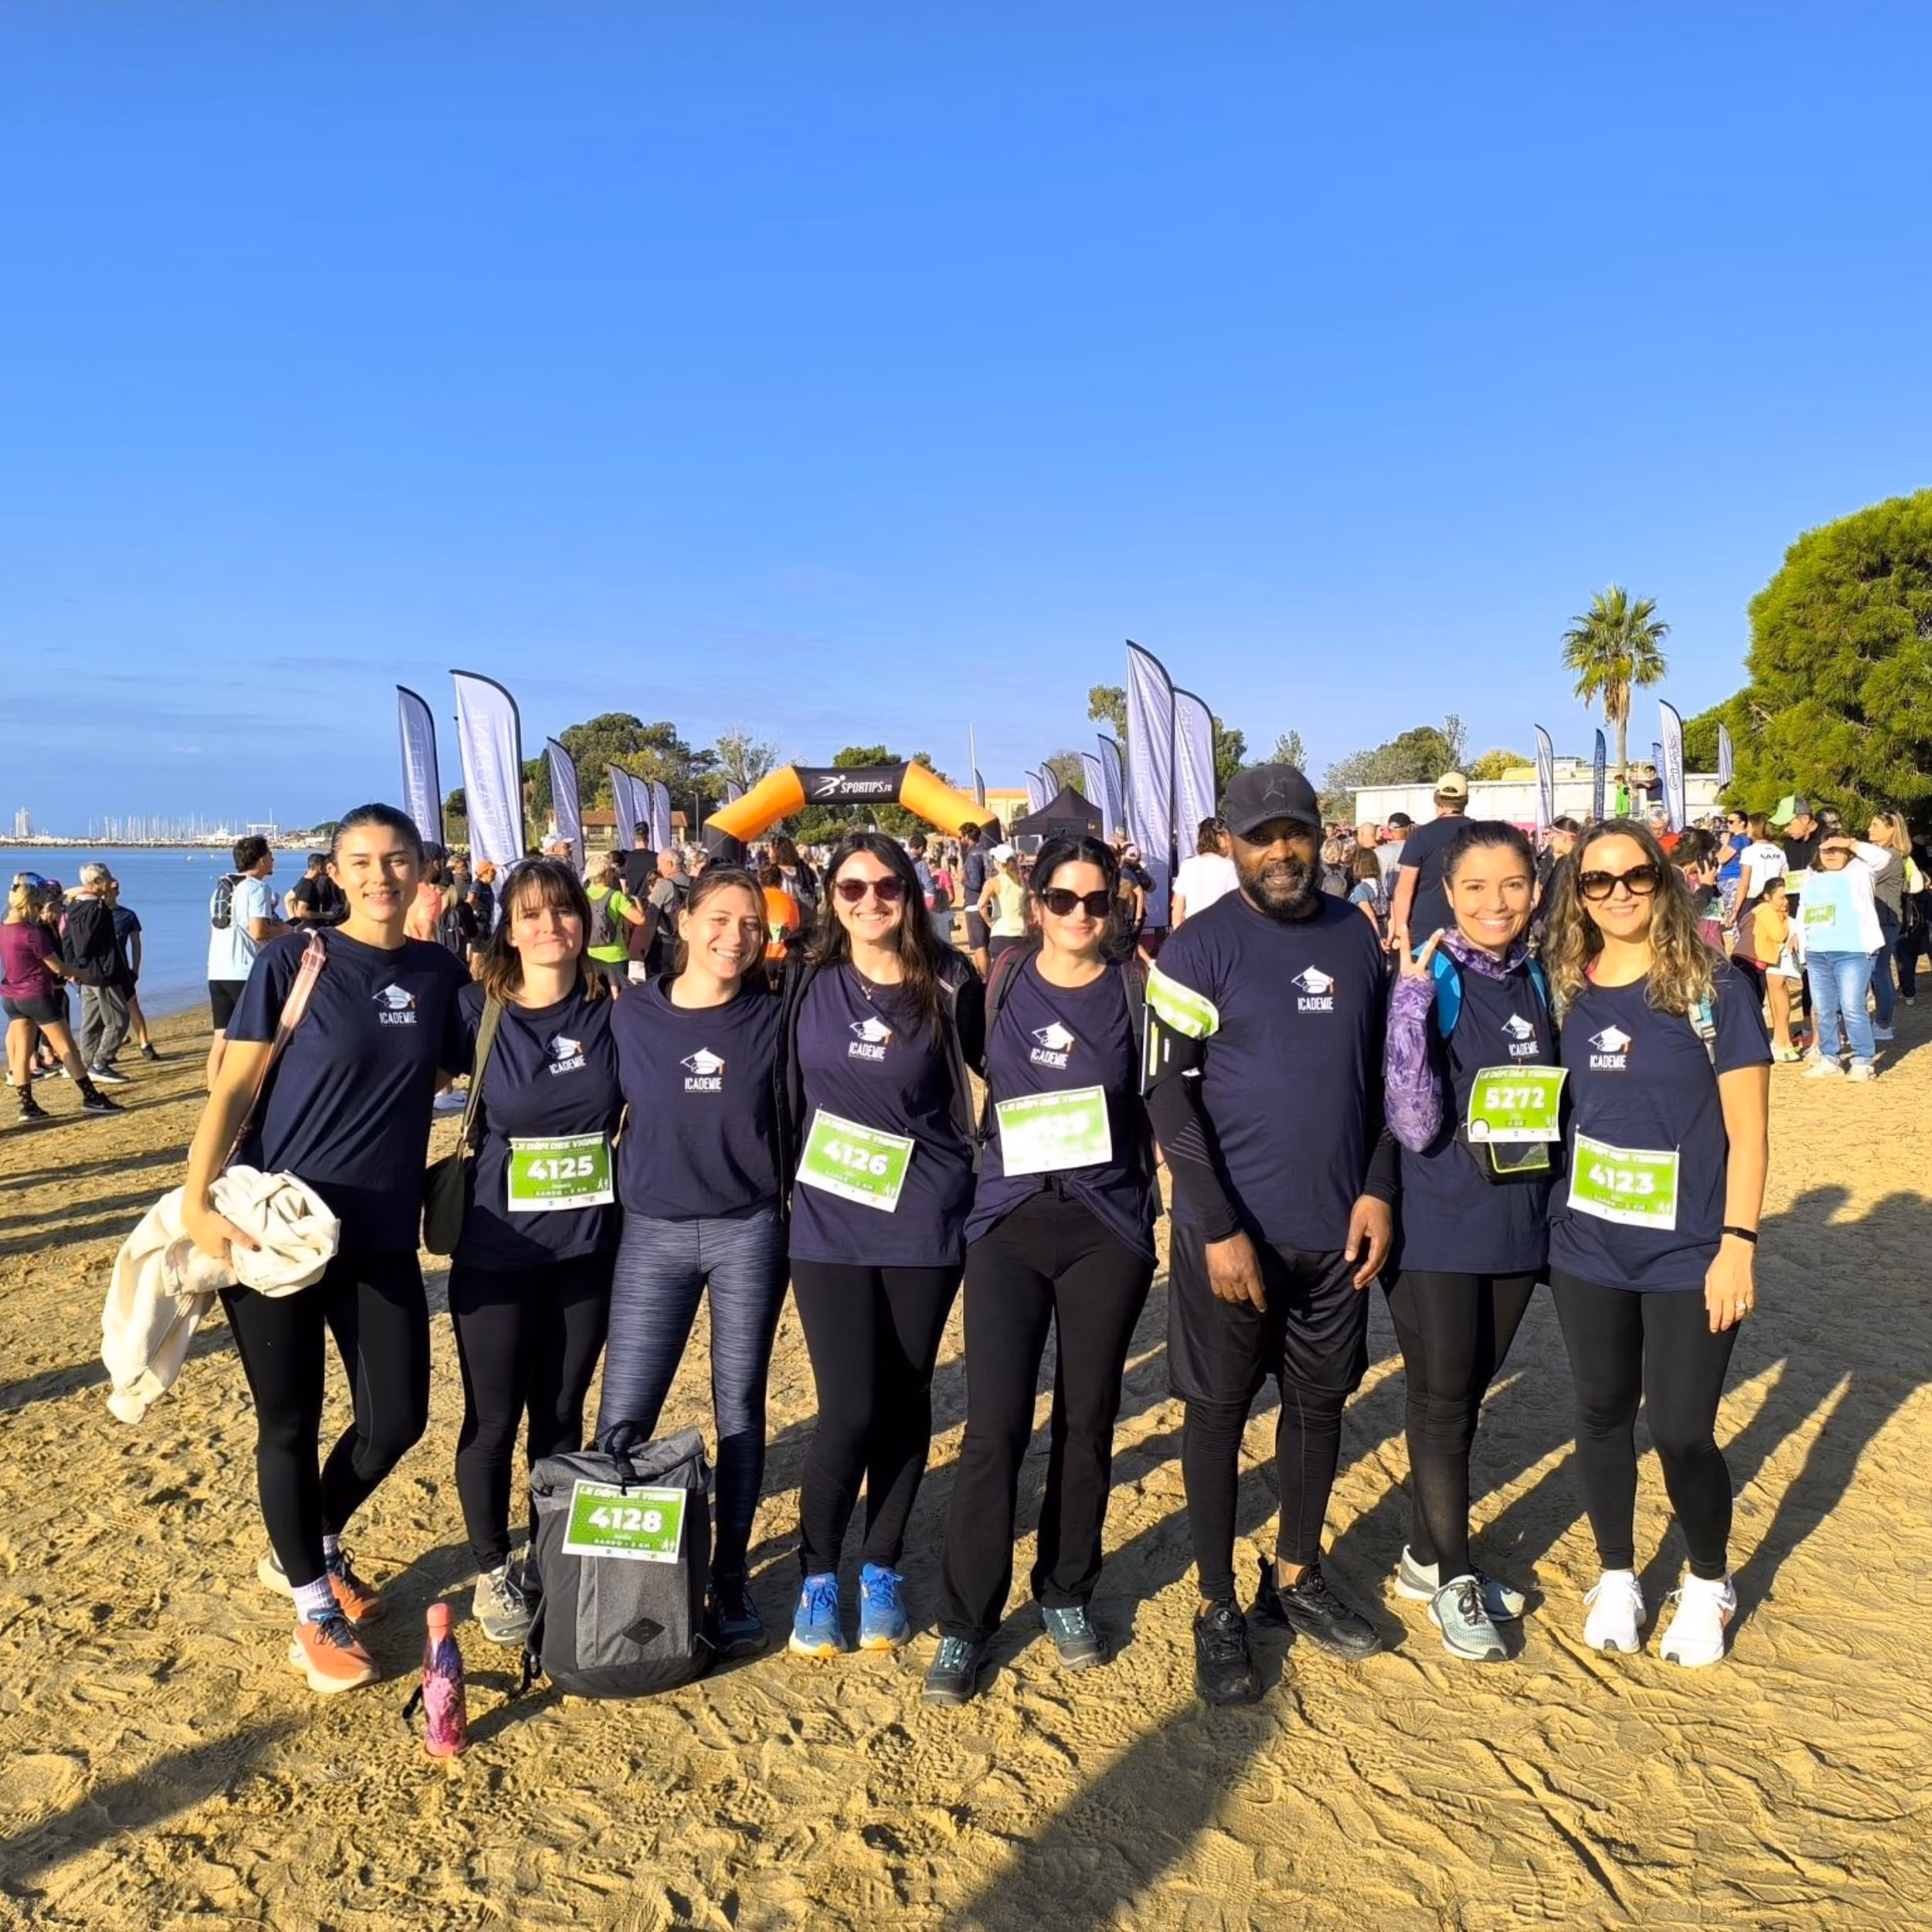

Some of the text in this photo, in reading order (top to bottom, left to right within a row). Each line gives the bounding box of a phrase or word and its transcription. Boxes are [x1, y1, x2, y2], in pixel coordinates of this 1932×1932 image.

[1298, 996, 1334, 1011] ICADEMIE
[379, 1011, 417, 1025] ICADEMIE
[849, 1042, 886, 1060] ICADEMIE
[1030, 1046, 1069, 1066] ICADEMIE
[1509, 1041, 1540, 1057] ICADEMIE
[549, 1055, 586, 1074] ICADEMIE
[1590, 1054, 1627, 1069] ICADEMIE
[685, 1077, 722, 1090] ICADEMIE
[1485, 1086, 1545, 1110] 5272
[823, 1138, 887, 1177] 4126
[527, 1155, 594, 1181] 4125
[1589, 1162, 1655, 1196] 4123
[588, 1506, 662, 1533] 4128
